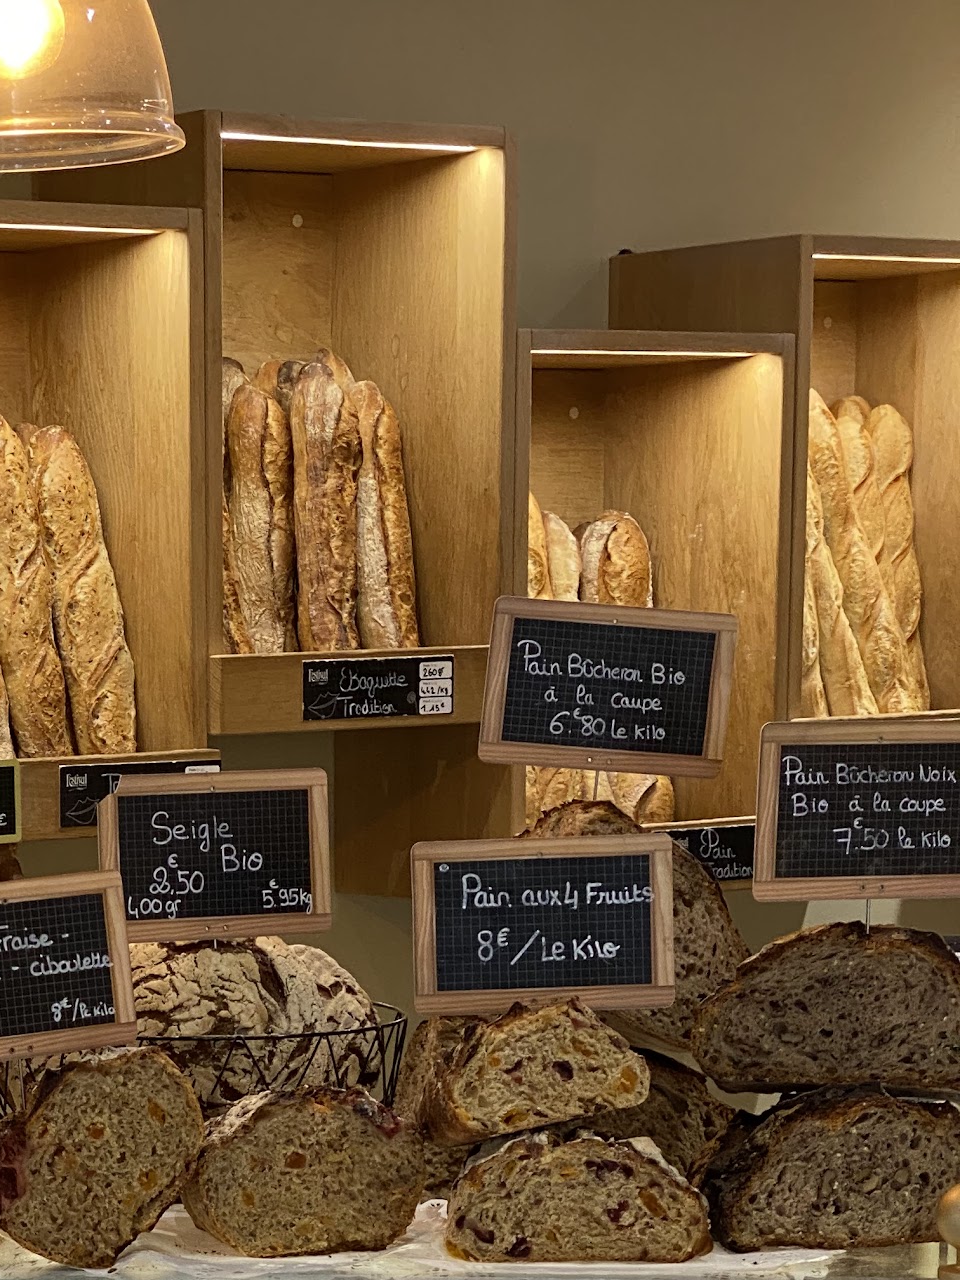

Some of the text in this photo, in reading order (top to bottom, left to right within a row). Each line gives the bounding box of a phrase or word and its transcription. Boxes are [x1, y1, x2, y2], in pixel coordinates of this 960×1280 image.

[517, 639, 563, 676] Pain
[651, 663, 686, 685] Bio
[340, 667, 408, 697] Baguette
[337, 696, 397, 717] Tradition
[576, 684, 594, 705] la
[611, 692, 663, 714] coupe
[782, 756, 829, 786] Pain
[919, 764, 957, 783] Noix
[791, 792, 829, 817] Bio
[873, 792, 891, 812] la
[899, 797, 947, 816] coupe
[151, 811, 233, 852] Seigle
[699, 828, 737, 858] Pain
[898, 826, 916, 849] le
[220, 844, 263, 872] Bio
[461, 872, 512, 910] Pain
[586, 882, 656, 905] Fruits
[29, 952, 114, 977] ciboulette
